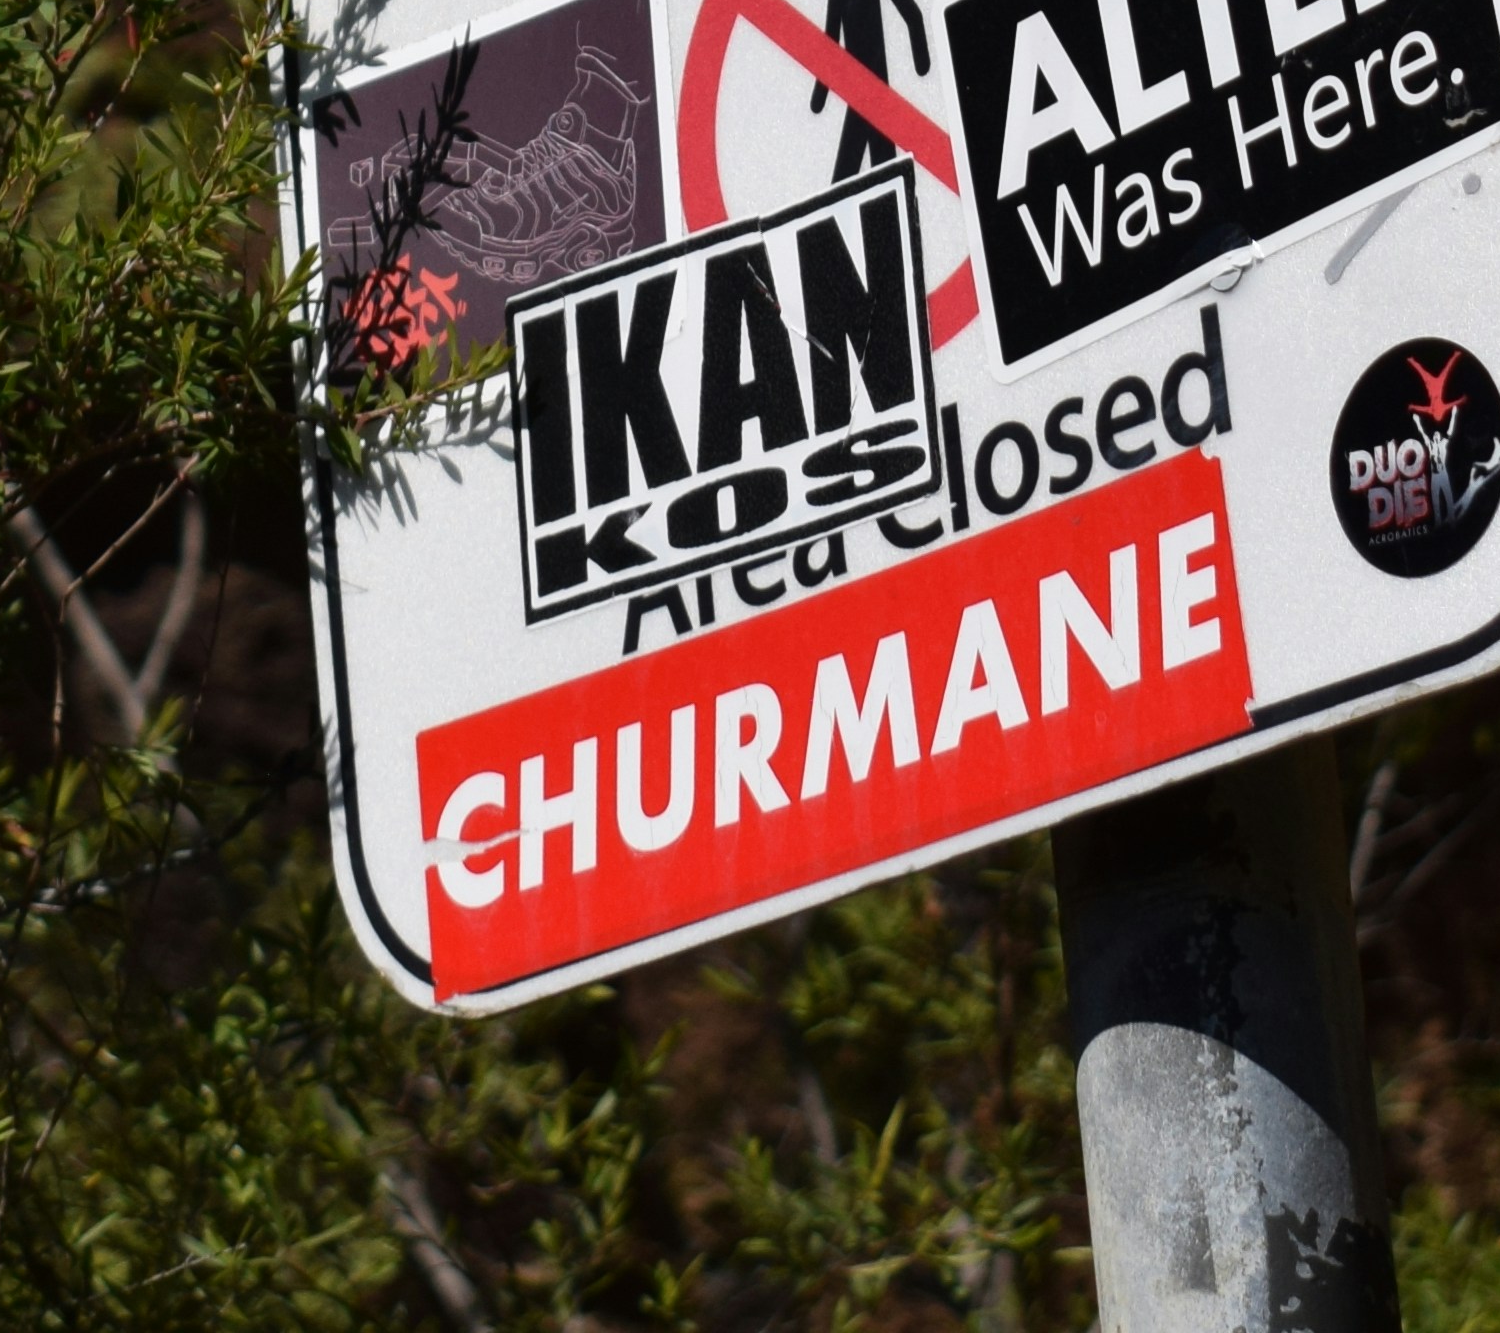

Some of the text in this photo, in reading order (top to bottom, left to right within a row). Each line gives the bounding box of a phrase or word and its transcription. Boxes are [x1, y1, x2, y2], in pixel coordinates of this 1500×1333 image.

[1017, 30, 1465, 289] Was Here.
[520, 193, 916, 527] IKAN
[874, 304, 1234, 550] losed
[1348, 437, 1428, 491] DUO
[534, 418, 928, 598] KOS
[1368, 524, 1429, 547] ACROBATICS
[433, 512, 1223, 909] CHURMANE
